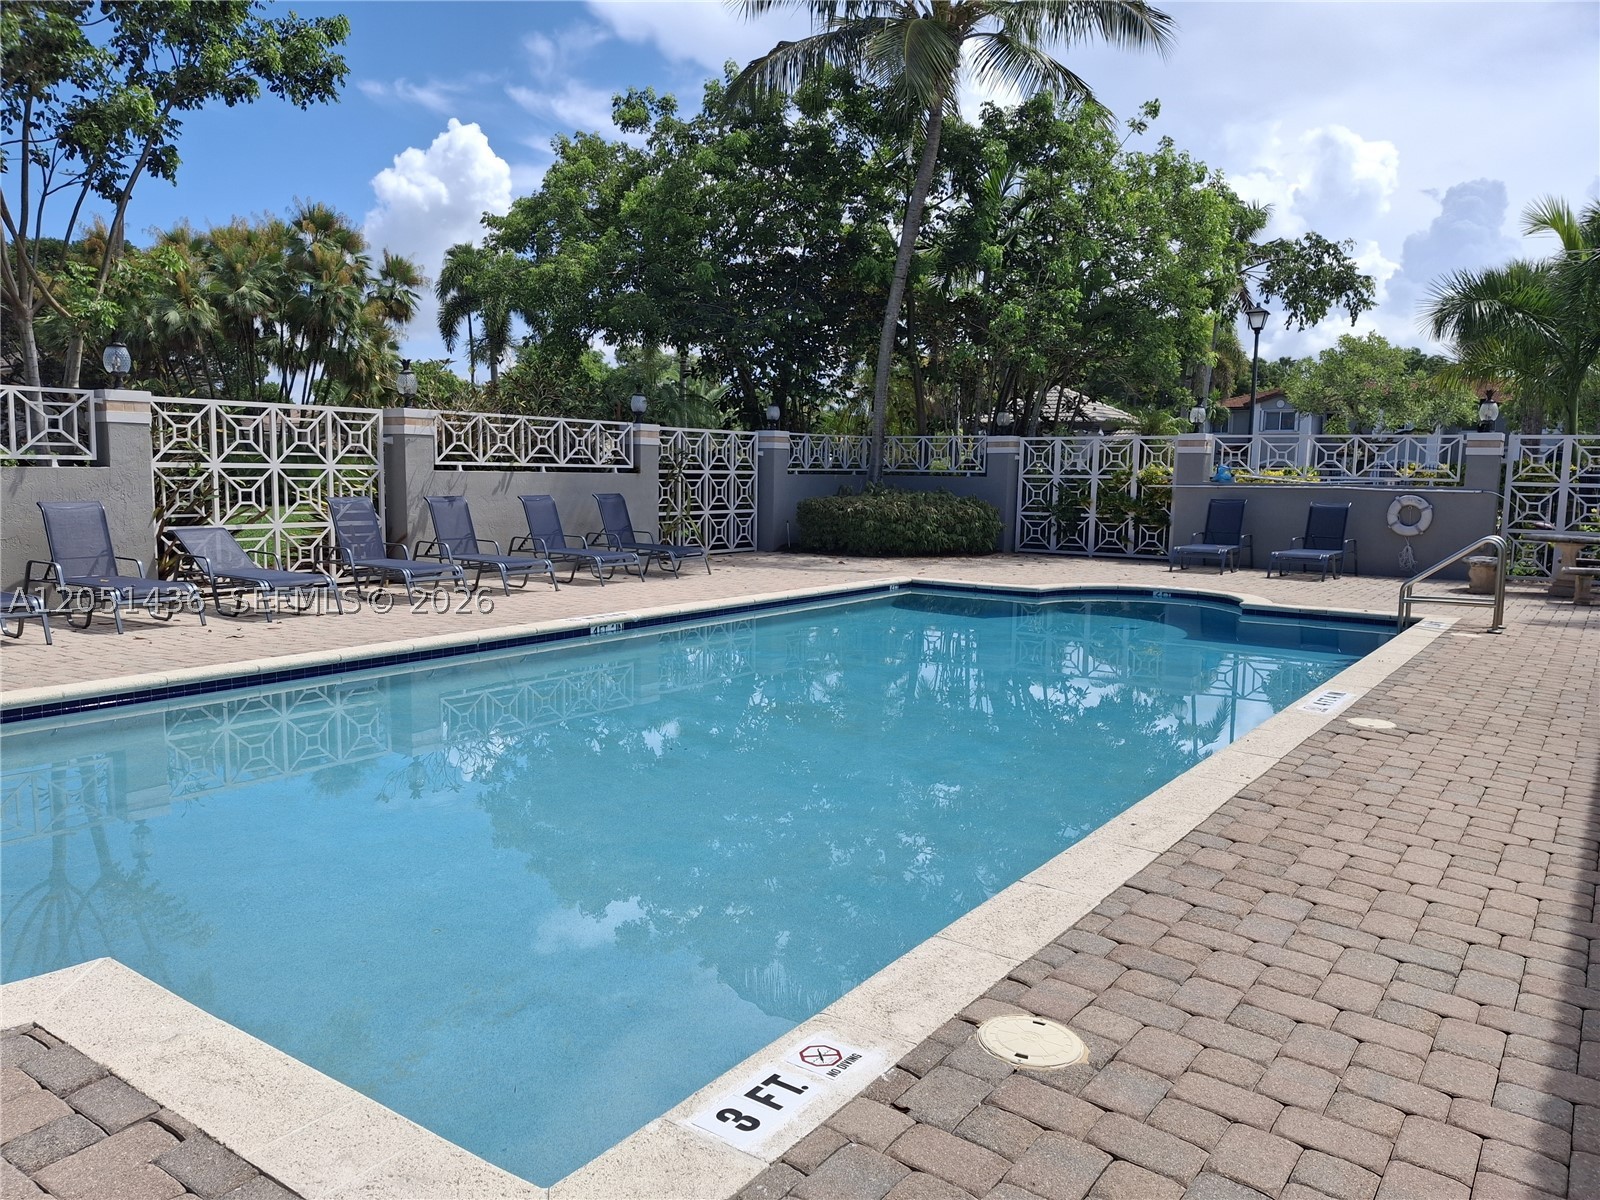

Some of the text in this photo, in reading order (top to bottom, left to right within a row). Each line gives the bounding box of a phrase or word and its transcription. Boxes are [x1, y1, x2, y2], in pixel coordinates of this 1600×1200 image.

[826, 1053, 863, 1078] NO DIVING
[715, 1073, 809, 1132] 3 FT.
